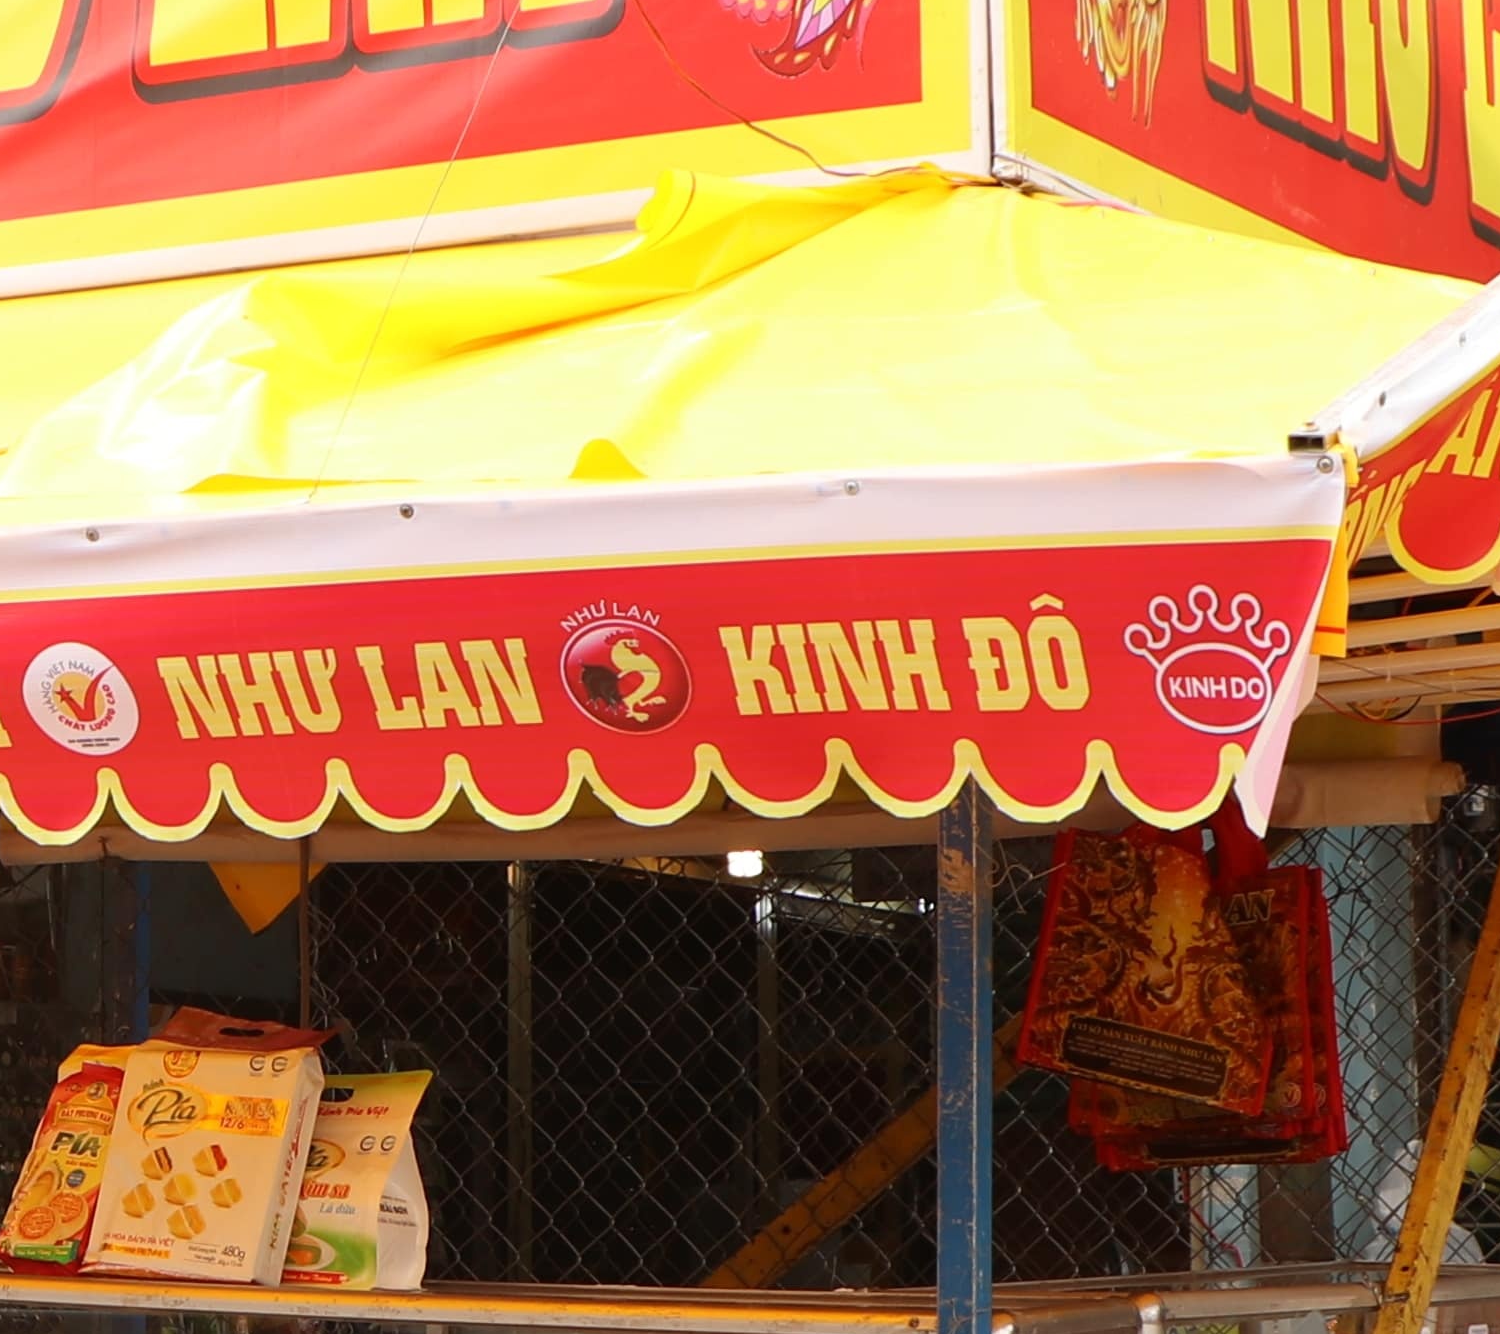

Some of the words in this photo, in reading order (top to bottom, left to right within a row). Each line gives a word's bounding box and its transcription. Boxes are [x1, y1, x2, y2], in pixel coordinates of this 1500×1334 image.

[559, 599, 607, 633] NHƯ
[612, 601, 661, 628] LAN
[718, 617, 953, 717] KINH
[960, 591, 1092, 713] ĐÔ
[155, 646, 343, 741] NHƯ
[355, 637, 545, 731] LAN
[50, 1130, 103, 1158] PÍA
